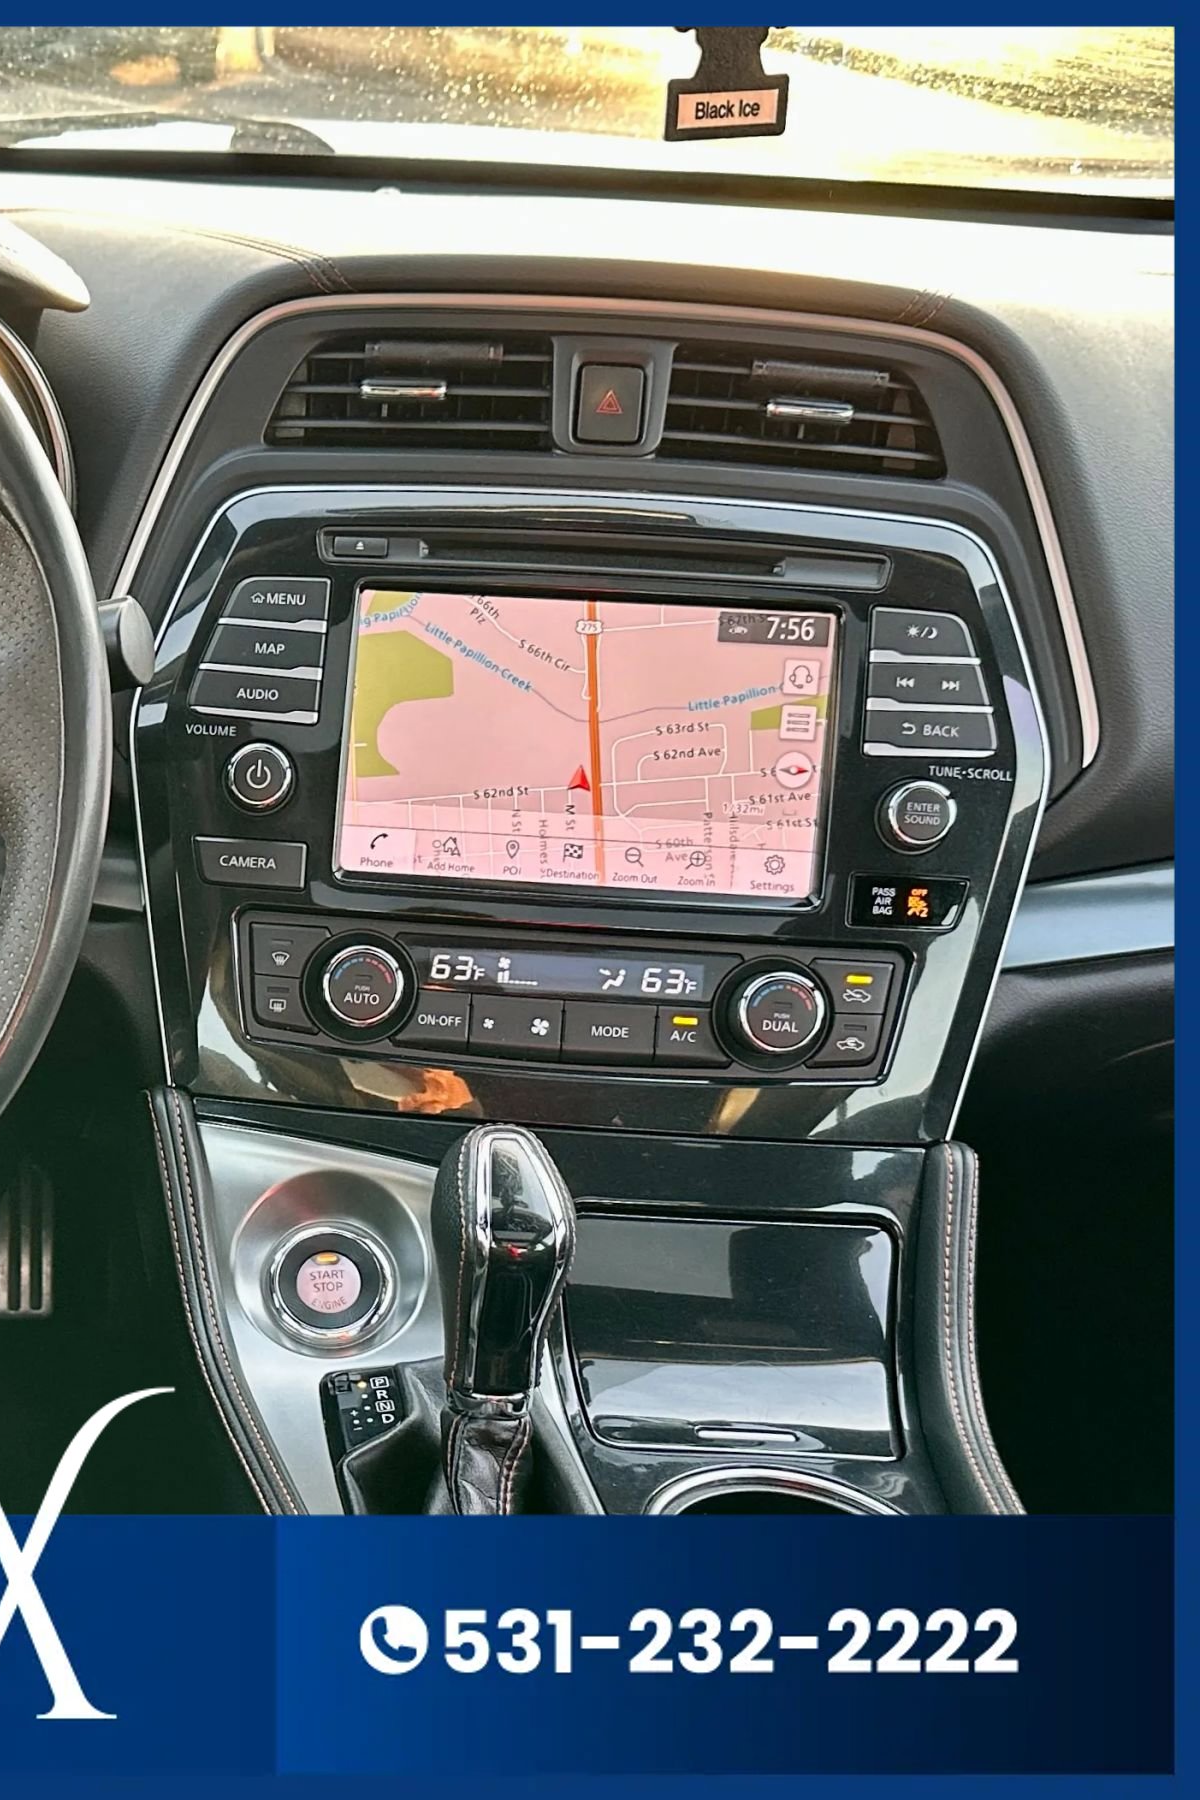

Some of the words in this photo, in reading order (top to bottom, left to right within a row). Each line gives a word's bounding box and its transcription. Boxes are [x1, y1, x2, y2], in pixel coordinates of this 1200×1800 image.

[695, 99, 735, 120] Black
[738, 99, 761, 118] Ice
[266, 591, 306, 606] MENU
[470, 606, 487, 625] Plz
[581, 623, 598, 632] 275
[766, 616, 815, 641] 7:56
[255, 641, 286, 655] MAP
[424, 621, 454, 645] Little
[453, 639, 500, 674] Papillion
[501, 668, 533, 692] Creek
[518, 639, 527, 649] S
[527, 643, 553, 664] 66th
[554, 658, 572, 672] Cir
[236, 687, 279, 701] AUDIO
[688, 695, 721, 712] Little
[723, 684, 776, 706] Papillion
[185, 724, 237, 737] VOLUME
[655, 725, 663, 735] S
[666, 723, 694, 735] 63rd
[697, 721, 710, 732] St
[923, 725, 960, 738] BACK
[653, 750, 660, 761] S
[664, 747, 695, 759] 62nd
[697, 746, 722, 757] Ave
[473, 789, 480, 800] S
[483, 786, 514, 799] 62nd
[517, 785, 529, 796] St
[748, 795, 756, 805] S
[759, 793, 785, 804] 61st
[788, 791, 811, 801] Ave
[565, 804, 576, 815] M
[906, 801, 941, 813] ENTER
[565, 819, 576, 831] St
[766, 820, 773, 830] S
[776, 818, 802, 828] 61st
[903, 814, 941, 826] SOUND
[219, 855, 277, 870] CAMERA
[360, 856, 394, 868] Phone
[665, 851, 688, 862] Ave
[427, 861, 446, 871] Add
[448, 862, 476, 873] Home
[546, 867, 600, 880] Destination
[612, 872, 639, 883] Zoom
[640, 874, 658, 885] Out
[677, 875, 704, 887] Zoom
[750, 880, 795, 893] Settings
[872, 887, 896, 897] PASS
[911, 888, 929, 897] OFF
[874, 896, 892, 905] AIR
[872, 905, 893, 915] BAG
[343, 991, 380, 1005] AUTO
[417, 1014, 462, 1027] ON-OFF
[762, 1019, 799, 1034] DUAL
[591, 1026, 630, 1039] MODE
[670, 1030, 697, 1043] A/C
[309, 1269, 345, 1281] START
[313, 1281, 344, 1293] STOP
[376, 1389, 389, 1400] R
[381, 1413, 395, 1424] D
